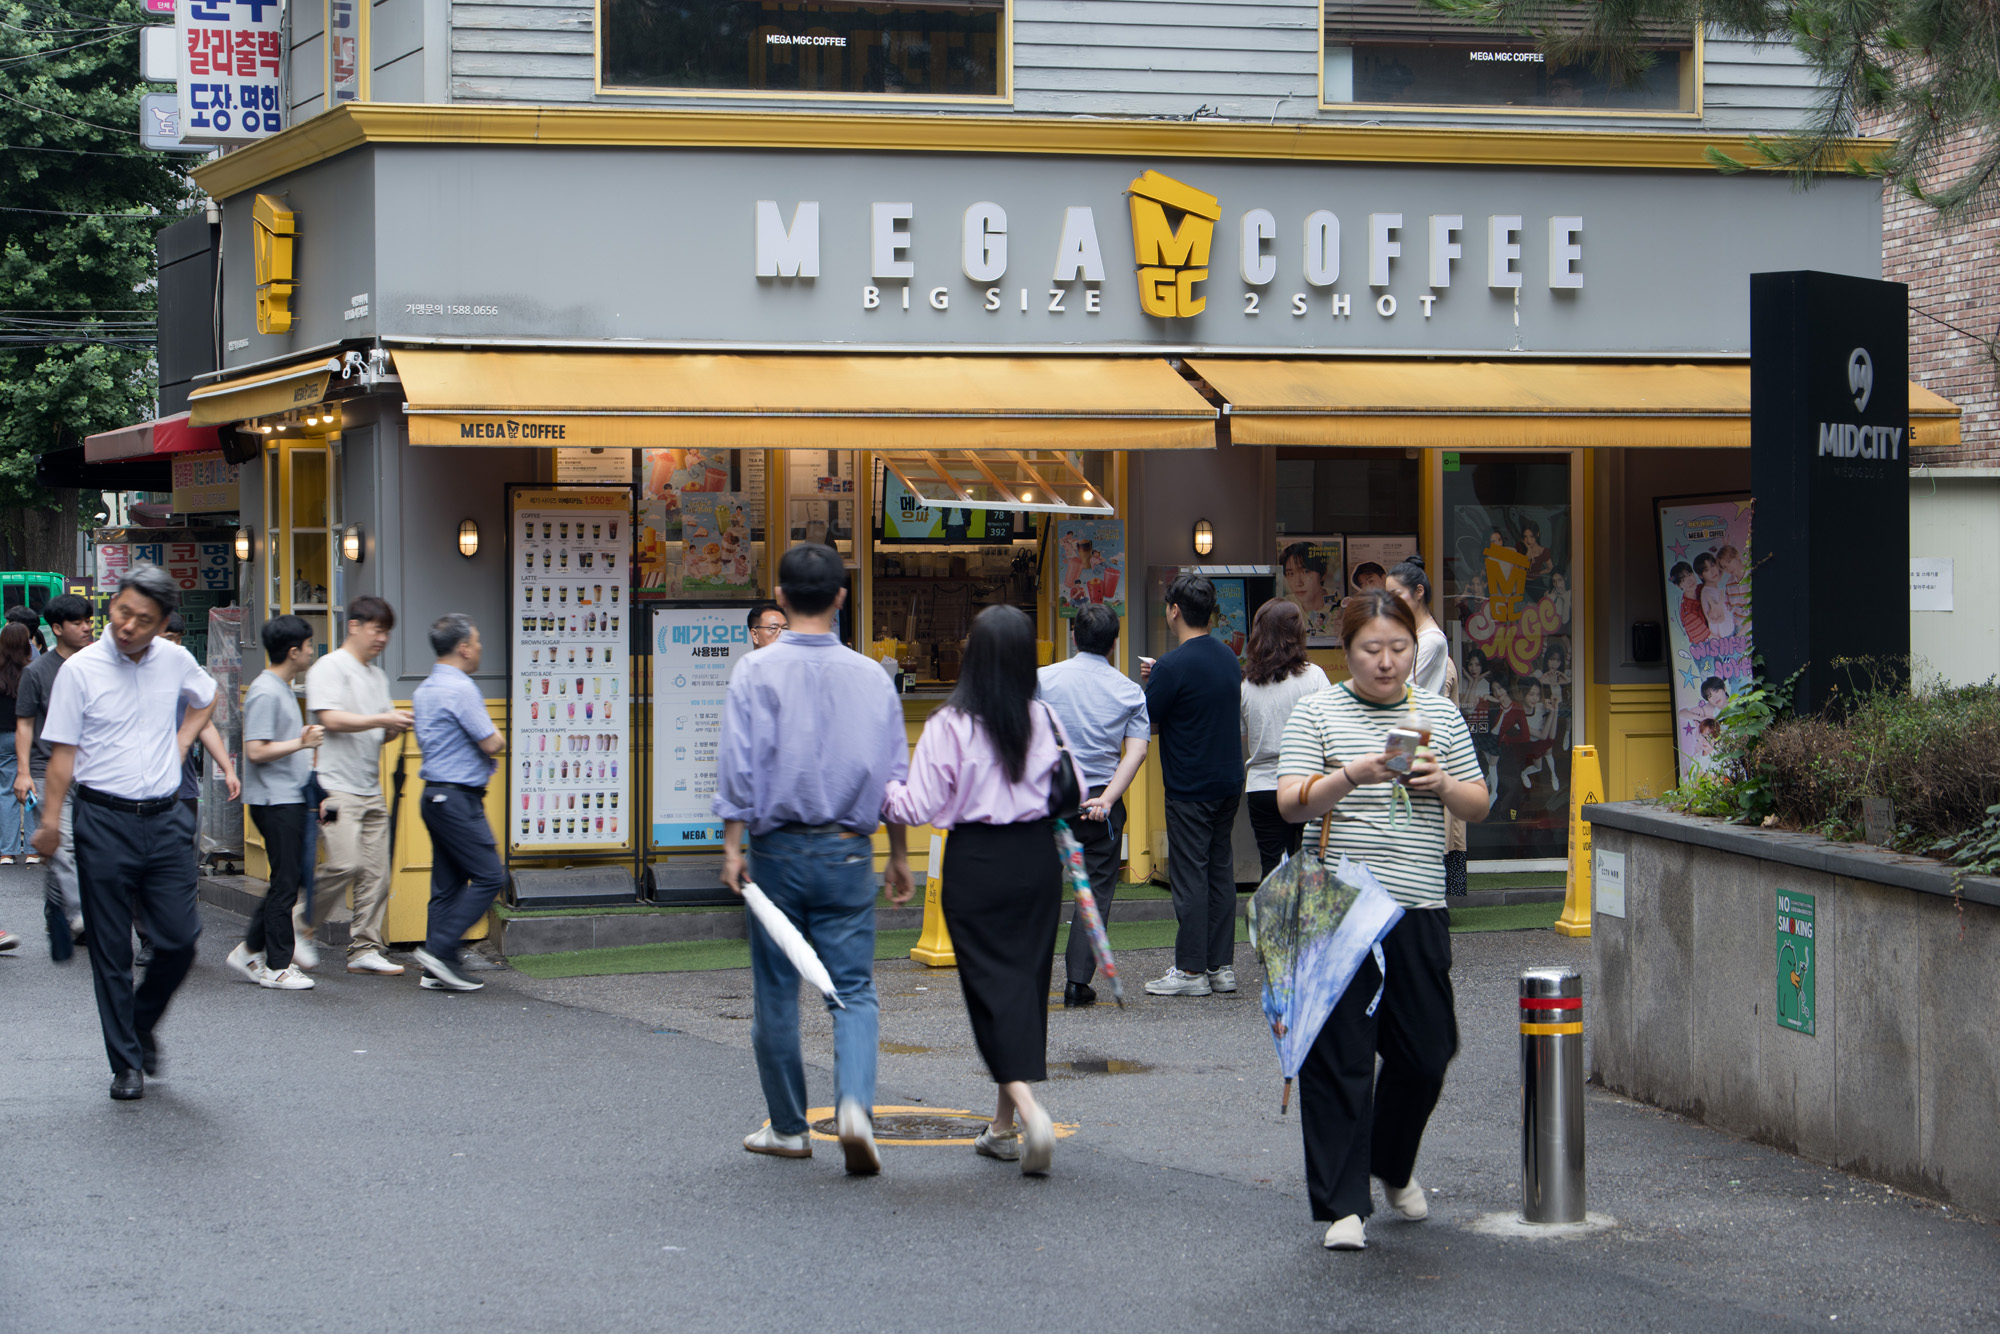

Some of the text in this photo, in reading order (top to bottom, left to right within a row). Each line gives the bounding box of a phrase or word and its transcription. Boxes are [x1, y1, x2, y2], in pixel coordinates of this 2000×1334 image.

[766, 34, 846, 46] MEGA MGC COFFEE
[188, 28, 279, 77] 칼라출력
[1470, 51, 1544, 63] MEGA MGC COFFEE
[755, 200, 1583, 289] MEGA COFFEE
[863, 286, 1101, 313] BIG SIZE
[1244, 292, 1437, 317] 2 SHOT
[405, 304, 498, 315] 가맹문의 1588.0656
[460, 423, 566, 439] MEGA COFFEE
[1818, 422, 1903, 460] MIDCITY
[900, 496, 928, 511] 메
[994, 511, 1004, 519] 78
[990, 528, 1006, 536] 392
[201, 544, 233, 589] 명함
[692, 647, 730, 657] 사용방법
[682, 831, 706, 840] MEGA
[1778, 896, 1790, 913] NO
